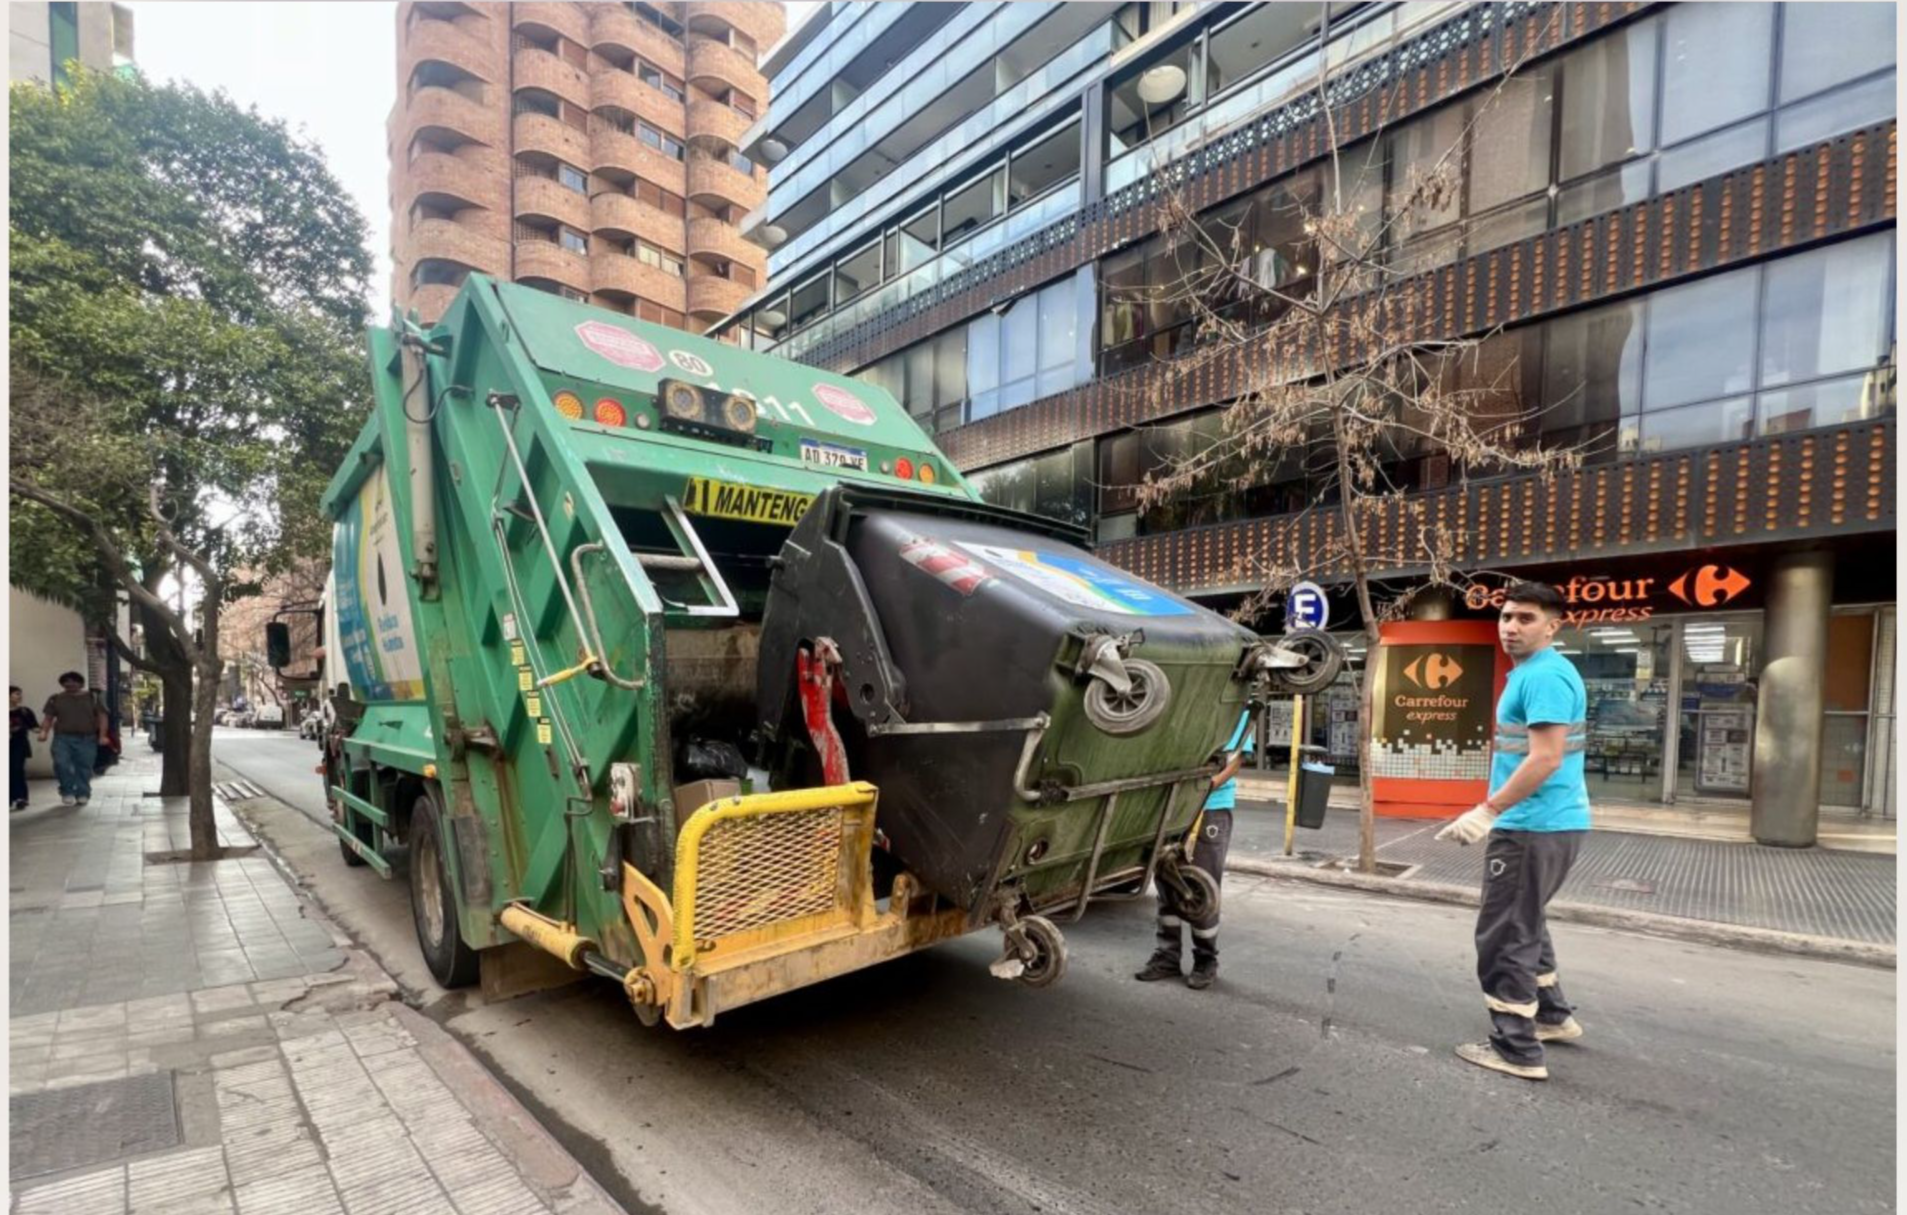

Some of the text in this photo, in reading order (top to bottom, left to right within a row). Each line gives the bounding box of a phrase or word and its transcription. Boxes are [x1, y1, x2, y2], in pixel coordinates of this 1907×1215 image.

[673, 353, 708, 374] 80
[804, 447, 820, 464] AD
[1294, 593, 1316, 628] E
[1565, 606, 1653, 631] xpress
[1394, 694, 1469, 708] Carrefour
[1405, 711, 1457, 725] express
